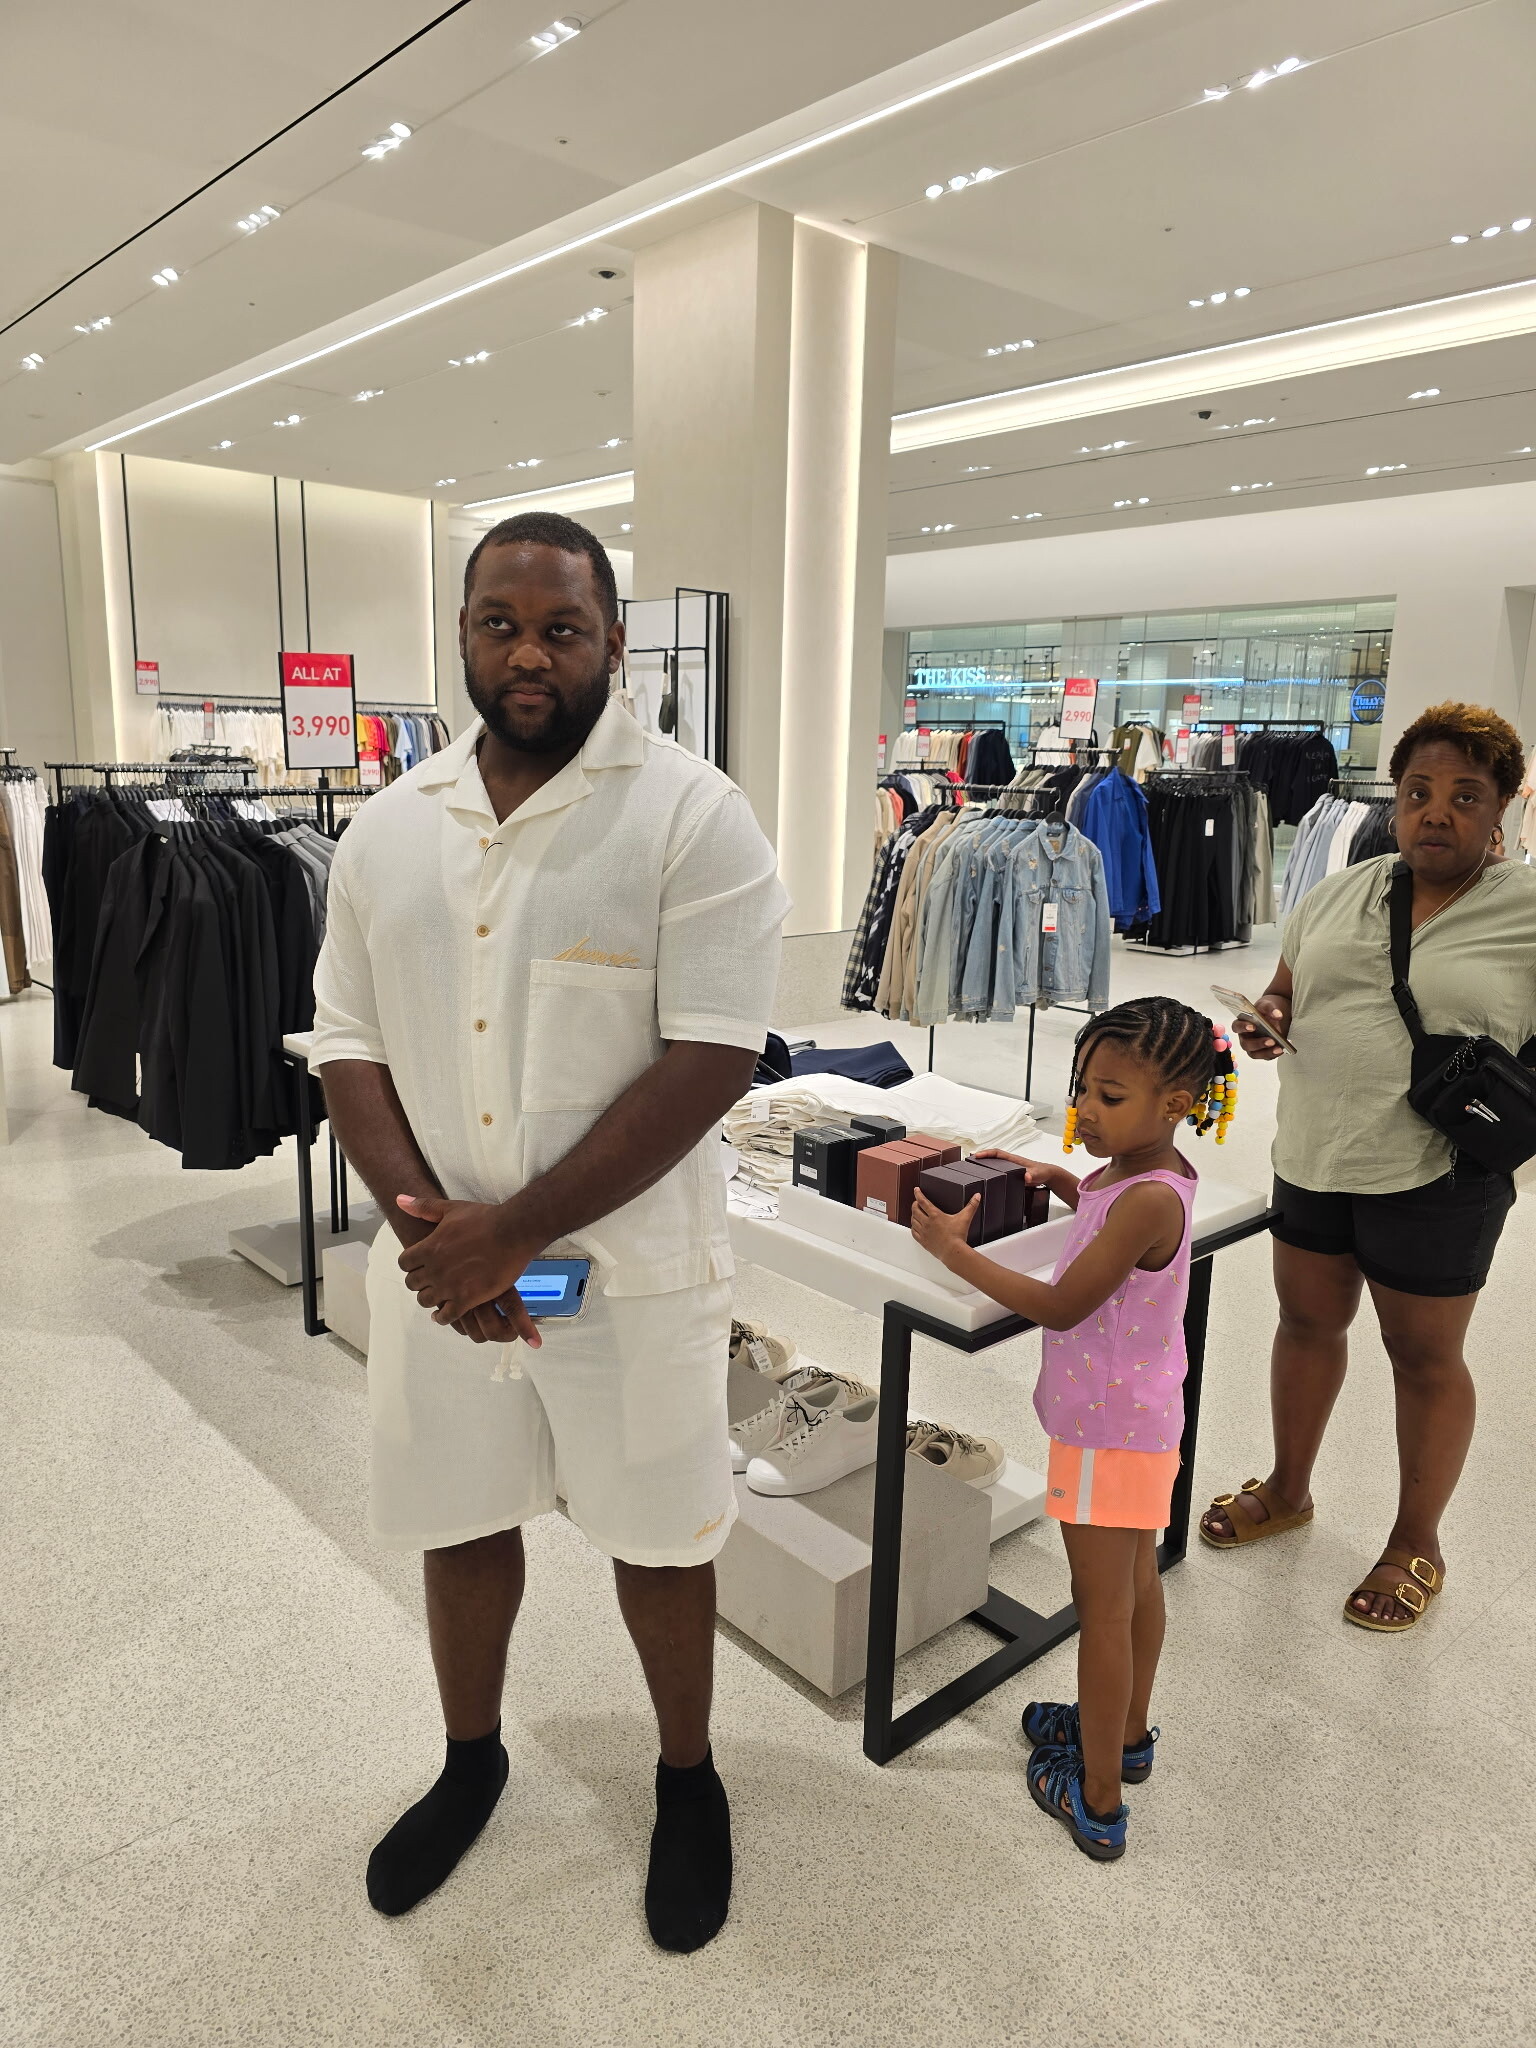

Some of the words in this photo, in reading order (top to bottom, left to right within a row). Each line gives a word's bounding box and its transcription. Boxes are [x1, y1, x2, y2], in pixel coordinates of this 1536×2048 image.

[291, 666, 320, 681] ALL
[322, 667, 342, 681] AT
[914, 667, 947, 685] THE
[950, 666, 986, 685] KISS
